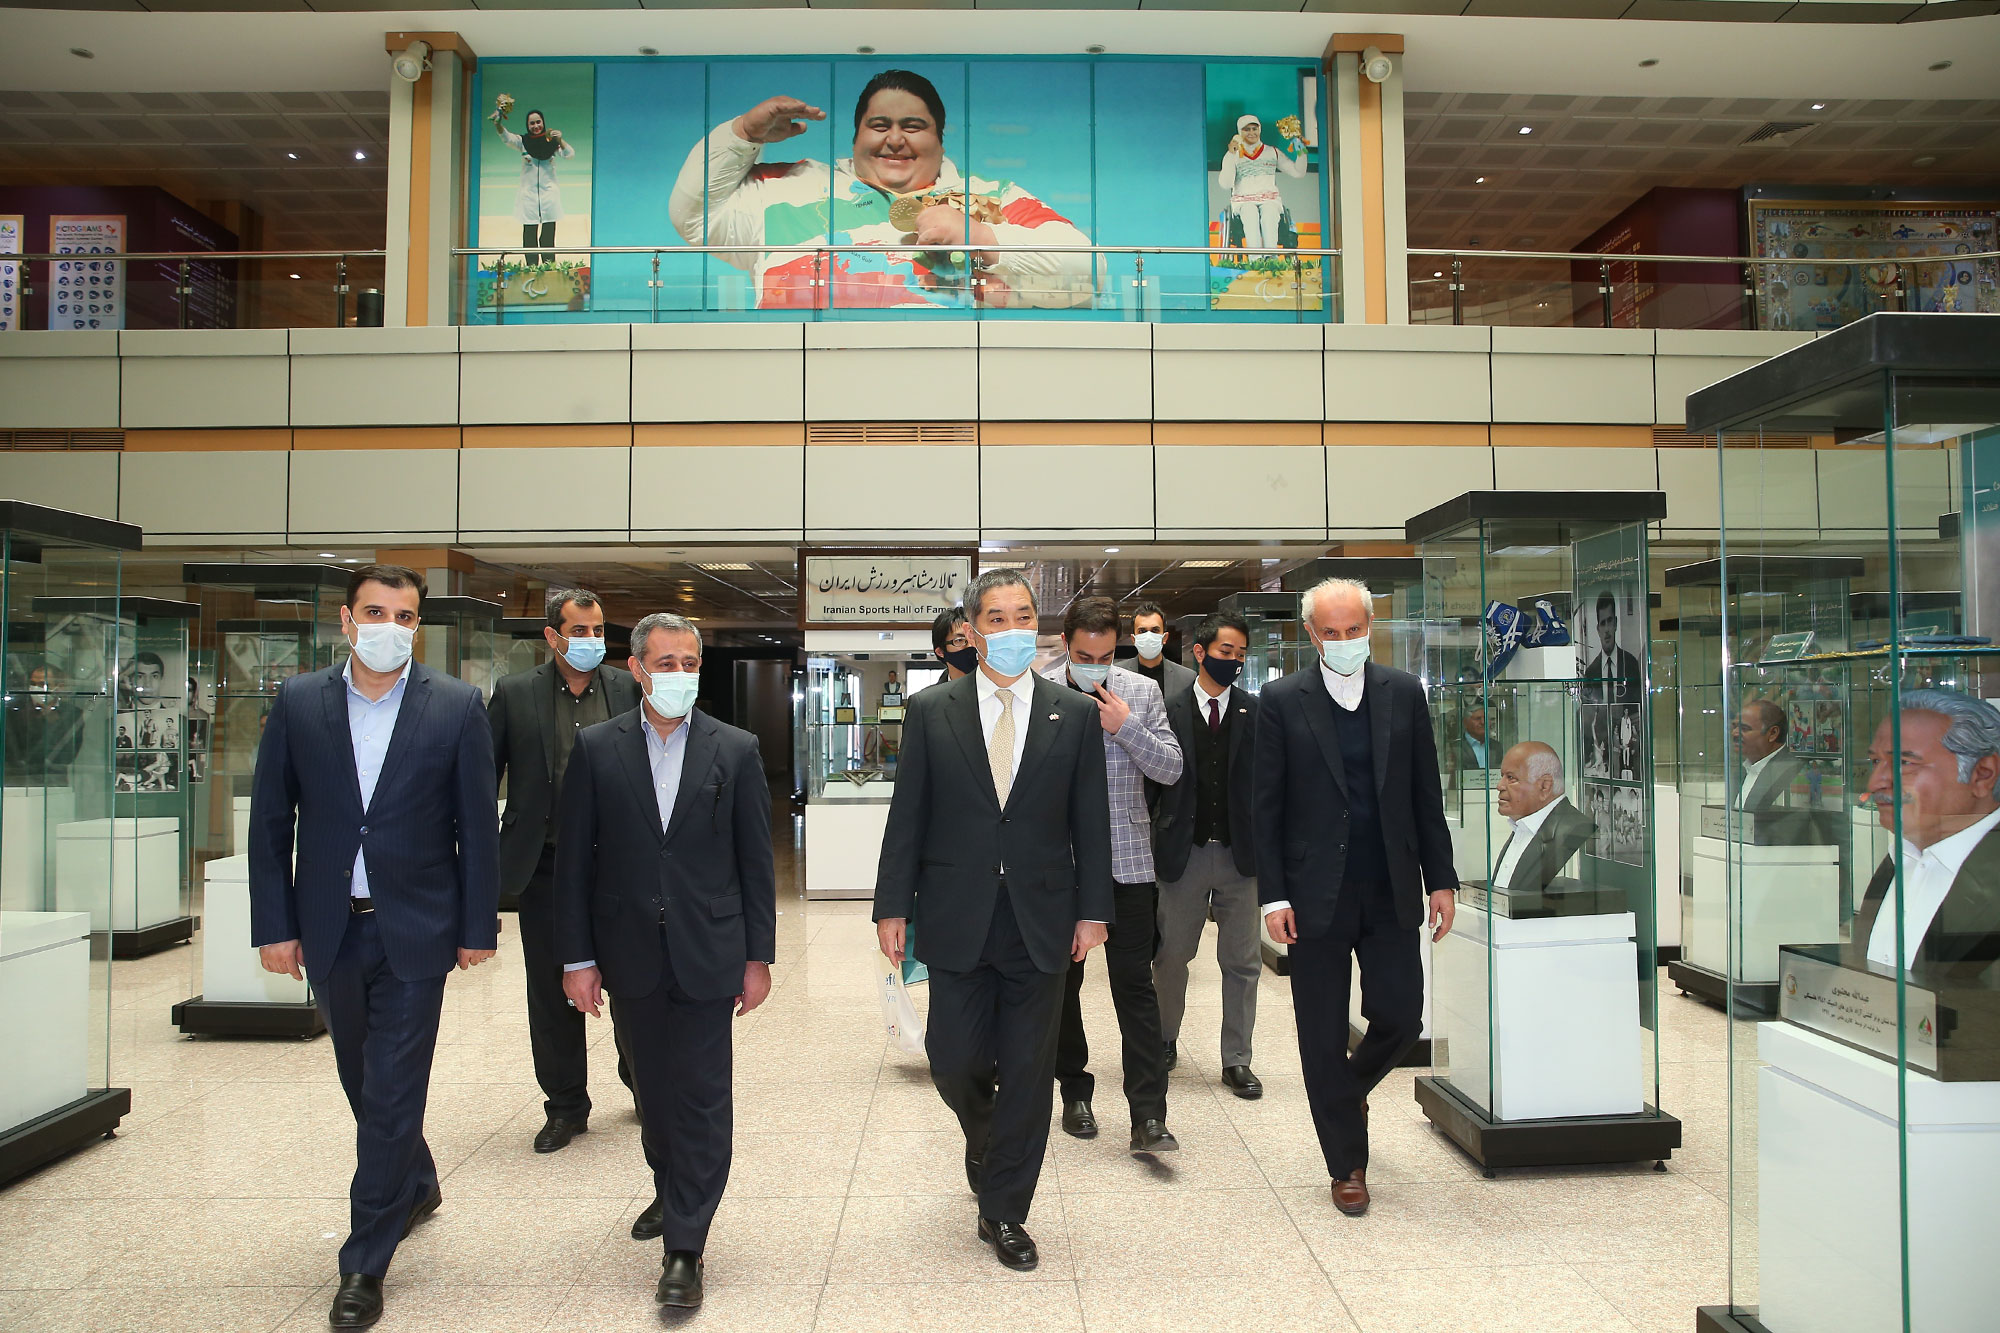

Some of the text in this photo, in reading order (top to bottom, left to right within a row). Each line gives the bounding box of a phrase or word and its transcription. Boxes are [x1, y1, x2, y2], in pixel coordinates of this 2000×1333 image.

[819, 575, 856, 593] ایران
[823, 605, 856, 614] Iranian
[858, 605, 891, 616] Sports
[893, 605, 912, 614] Hall
[914, 605, 925, 614] of
